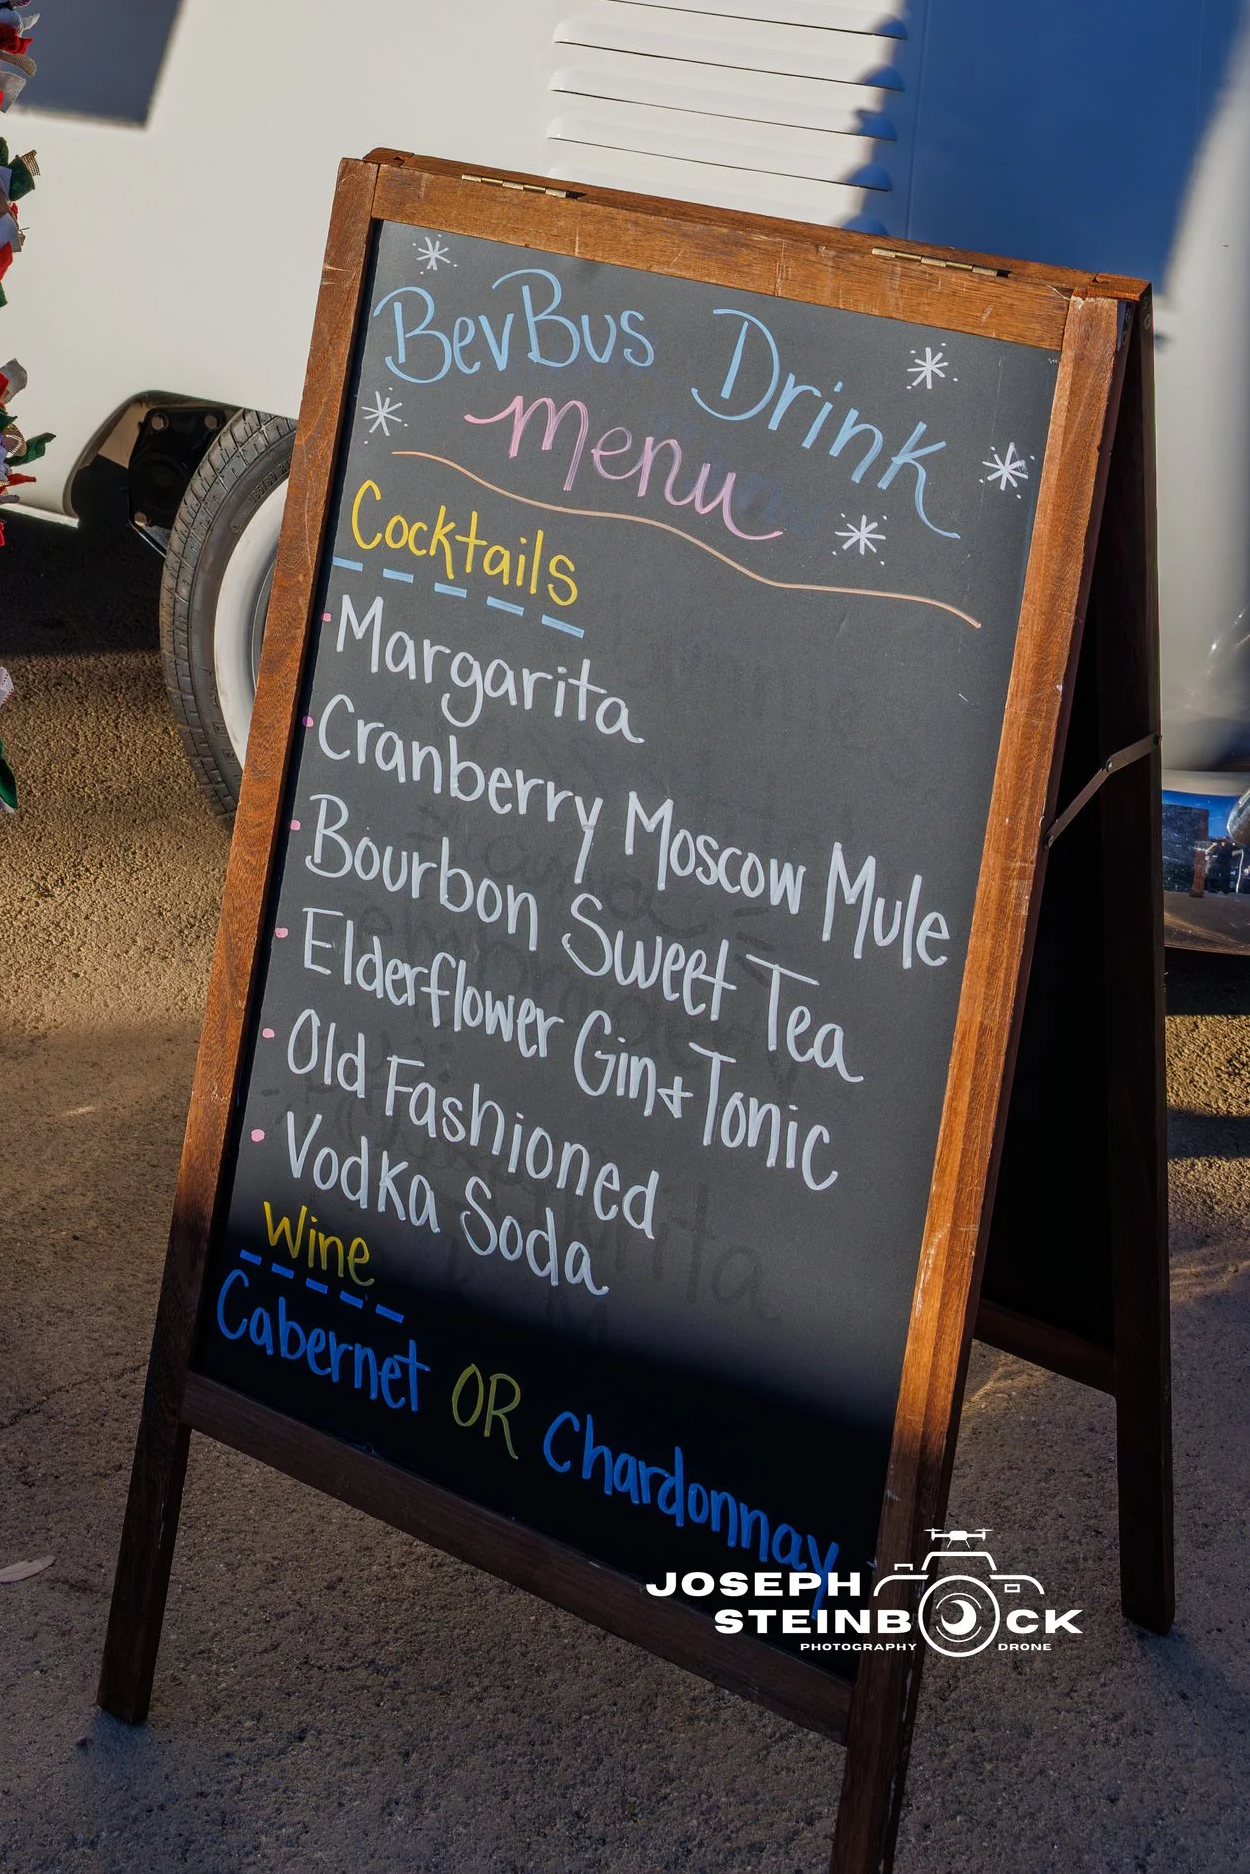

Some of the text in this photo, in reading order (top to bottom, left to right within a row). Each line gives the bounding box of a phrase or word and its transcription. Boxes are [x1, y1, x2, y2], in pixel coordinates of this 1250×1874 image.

[691, 307, 960, 539] Drink
[351, 479, 578, 607] Cocktails
[336, 594, 645, 745] Margarita
[305, 794, 864, 1083] Bourbon Sweet Tea
[318, 693, 951, 969] Cranberry Moscow Mule
[302, 907, 564, 1058] Elderflower
[286, 1010, 659, 1240] Old Fashioned
[286, 1110, 609, 1296] Vodka Soda
[216, 1268, 839, 1619] Cabernet OR Chardonnay
